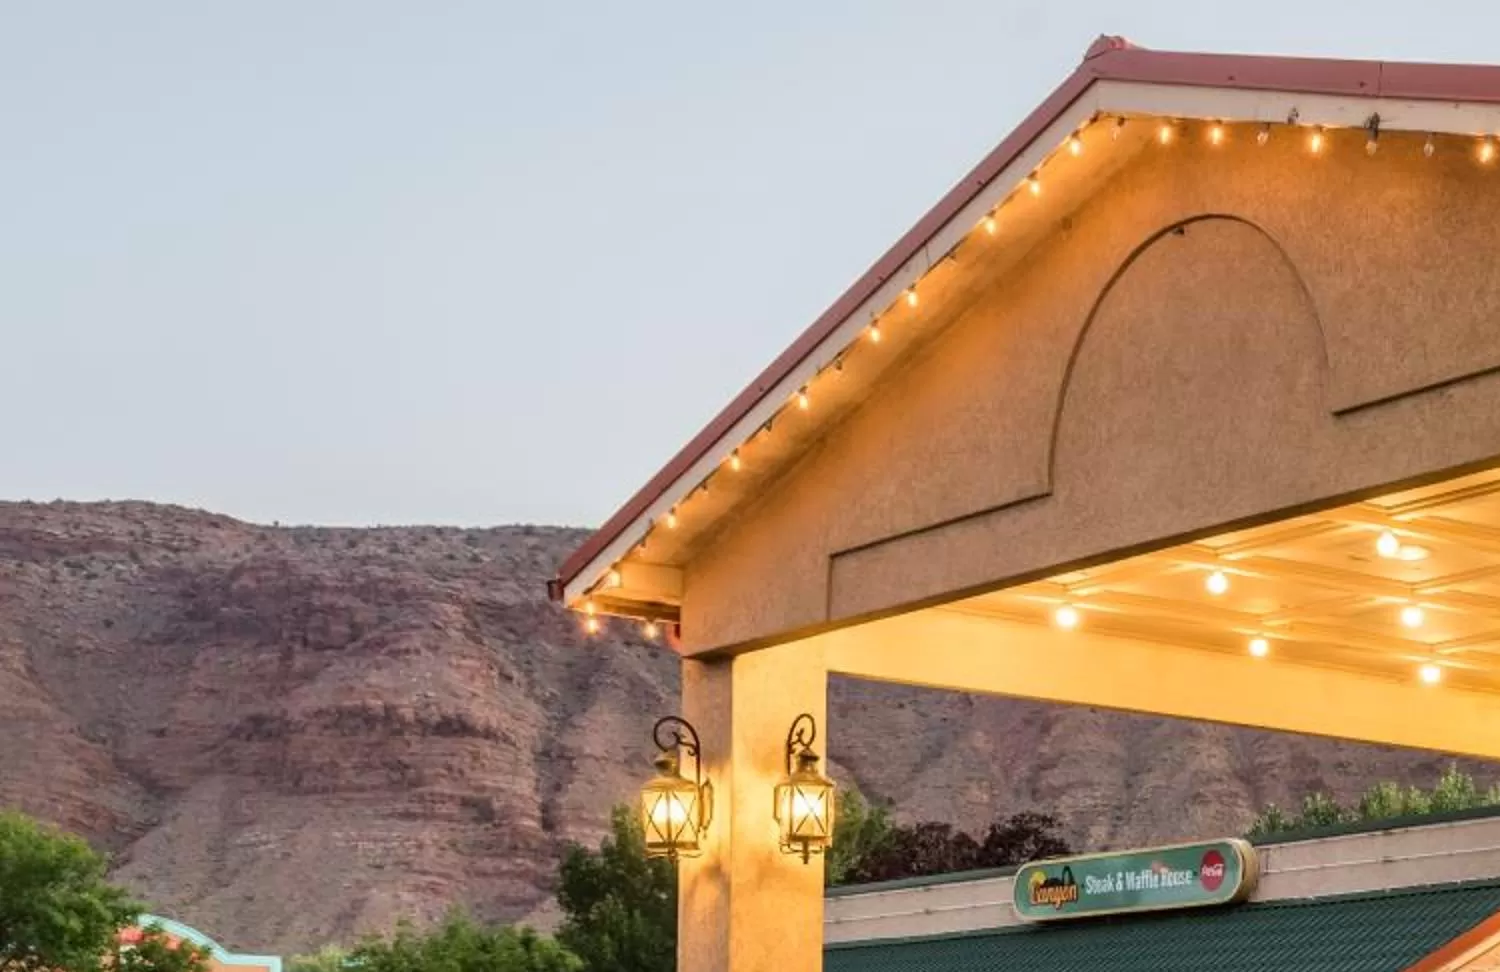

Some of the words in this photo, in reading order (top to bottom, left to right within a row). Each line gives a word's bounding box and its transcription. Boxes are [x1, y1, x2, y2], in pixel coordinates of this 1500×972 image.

[1085, 873, 1115, 895] Steak
[1116, 871, 1124, 892] &
[1125, 868, 1159, 891] Waffle
